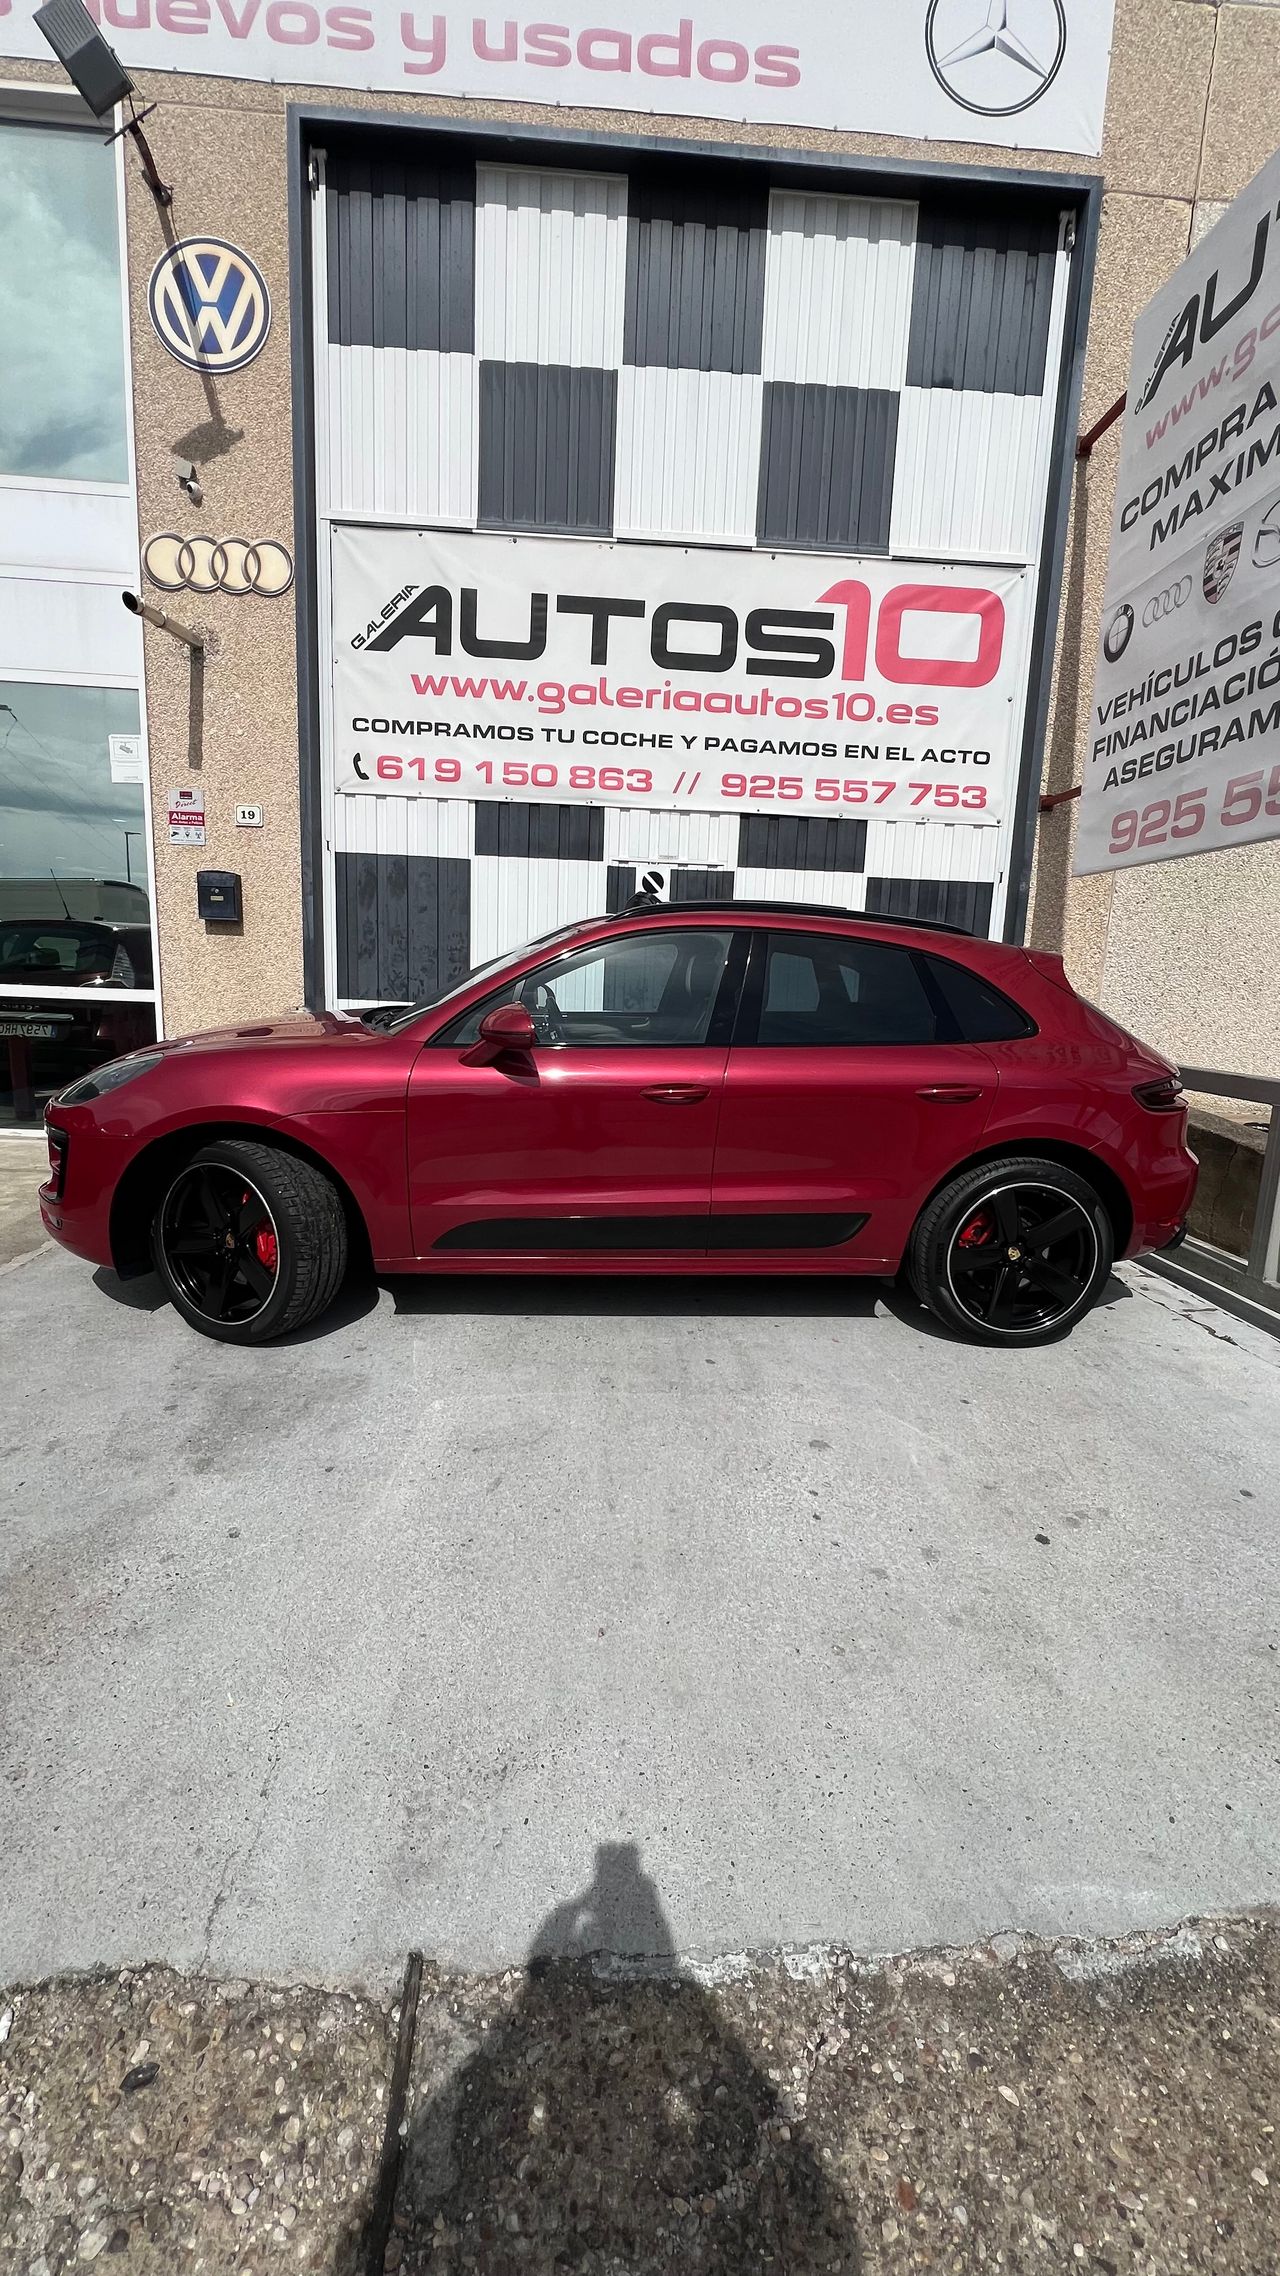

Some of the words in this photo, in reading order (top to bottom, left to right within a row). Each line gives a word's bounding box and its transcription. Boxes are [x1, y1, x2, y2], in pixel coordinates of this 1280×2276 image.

[400, 12, 447, 76] y
[472, 18, 801, 88] usados
[1141, 198, 1280, 410] AU
[1120, 381, 1278, 533] COMPRA
[1149, 423, 1280, 552] MAXIM
[350, 584, 420, 651] GALERIA
[410, 673, 939, 726] www.galeriaautos10.es
[1092, 647, 1280, 763] FINANCIACIÓ
[1096, 620, 1263, 727] VEHÍCULOS
[352, 717, 534, 742] COMPRAMOS
[541, 727, 575, 744] TU
[582, 730, 674, 748] COCHE
[681, 735, 698, 749] Y
[704, 736, 838, 758] PAGAMOS
[844, 744, 879, 760] EN
[885, 746, 915, 761] EL
[921, 748, 991, 765] ACTO
[1102, 700, 1280, 793] ASEGURAM
[175, 799, 198, 809] Direct
[240, 810, 256, 820] 19
[376, 754, 462, 783] 619
[475, 760, 559, 788] 150
[568, 765, 653, 793] 863
[720, 772, 804, 800] 925
[814, 778, 897, 804] 557
[907, 782, 987, 810] 753
[171, 812, 203, 821] Alarma
[1108, 787, 1209, 855] 925
